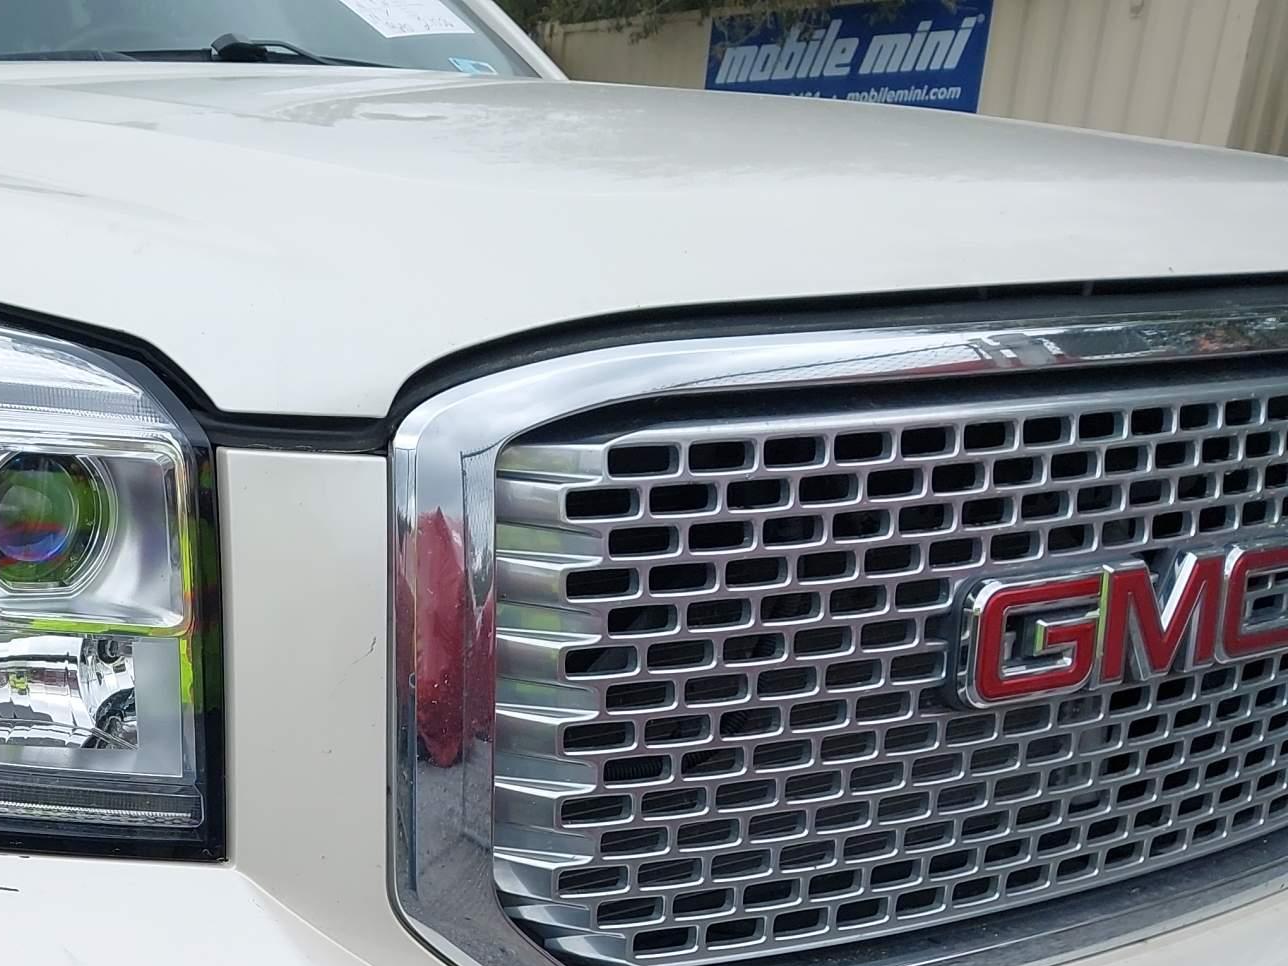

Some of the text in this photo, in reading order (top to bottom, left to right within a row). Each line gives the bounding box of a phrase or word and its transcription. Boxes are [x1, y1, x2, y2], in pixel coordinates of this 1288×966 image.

[714, 16, 978, 85] mobile mini
[846, 85, 962, 104] mobilemini.com
[970, 543, 1288, 709] GMC
